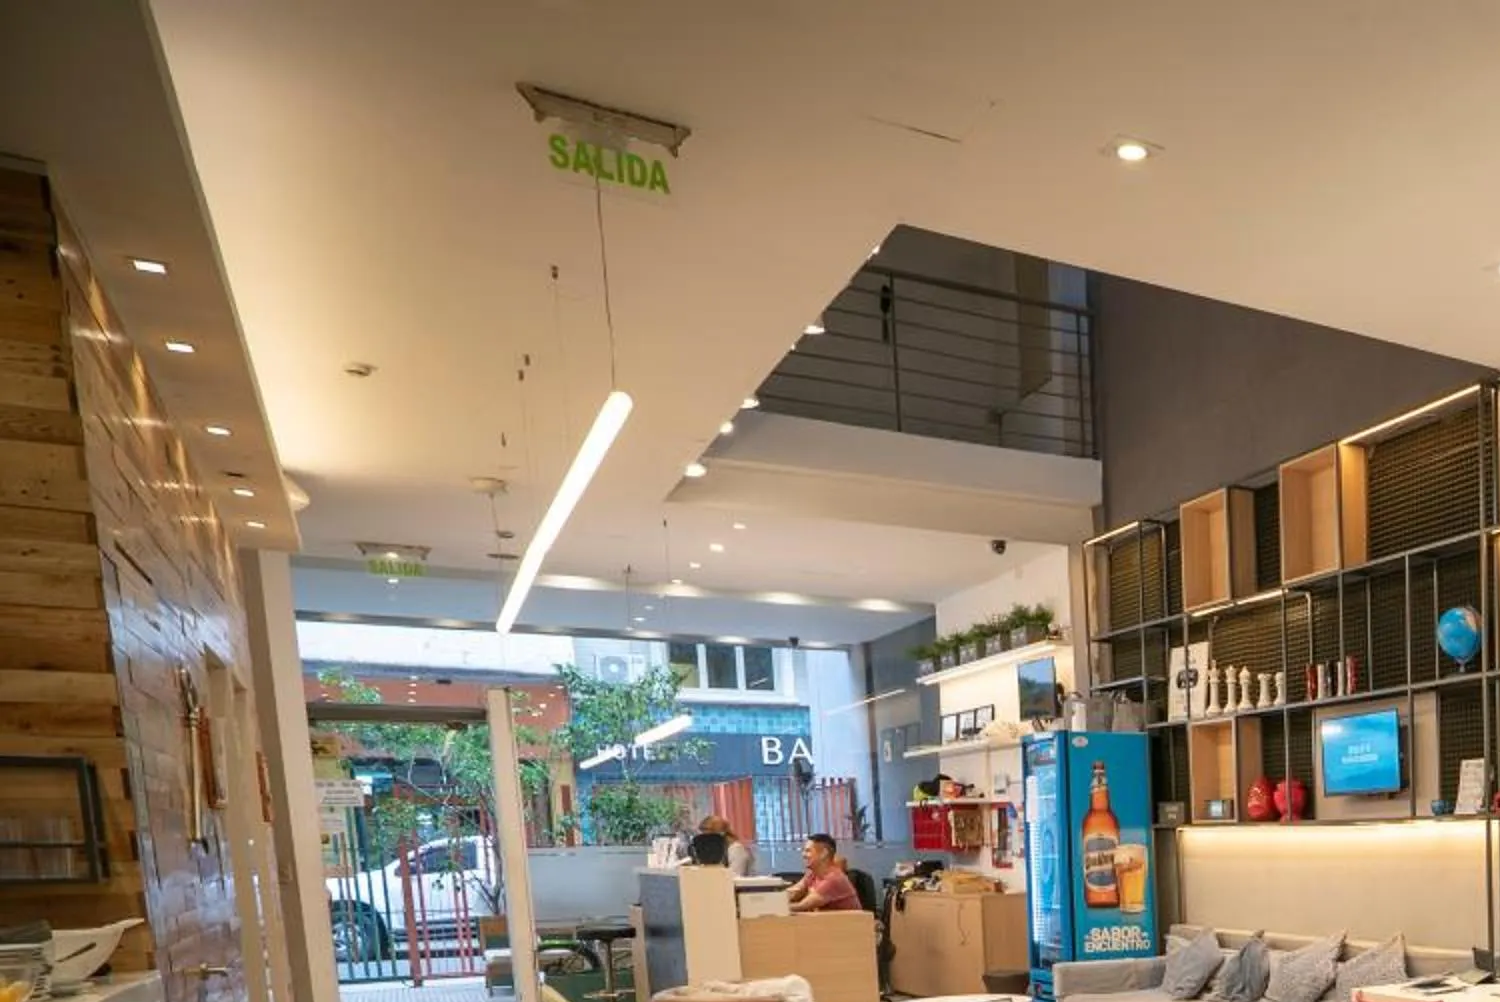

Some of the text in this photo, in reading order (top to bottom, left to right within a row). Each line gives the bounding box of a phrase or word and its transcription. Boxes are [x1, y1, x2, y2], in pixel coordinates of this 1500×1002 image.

[548, 134, 671, 195] SALIDA
[761, 736, 814, 766] BA
[1090, 926, 1142, 941] SABOR
